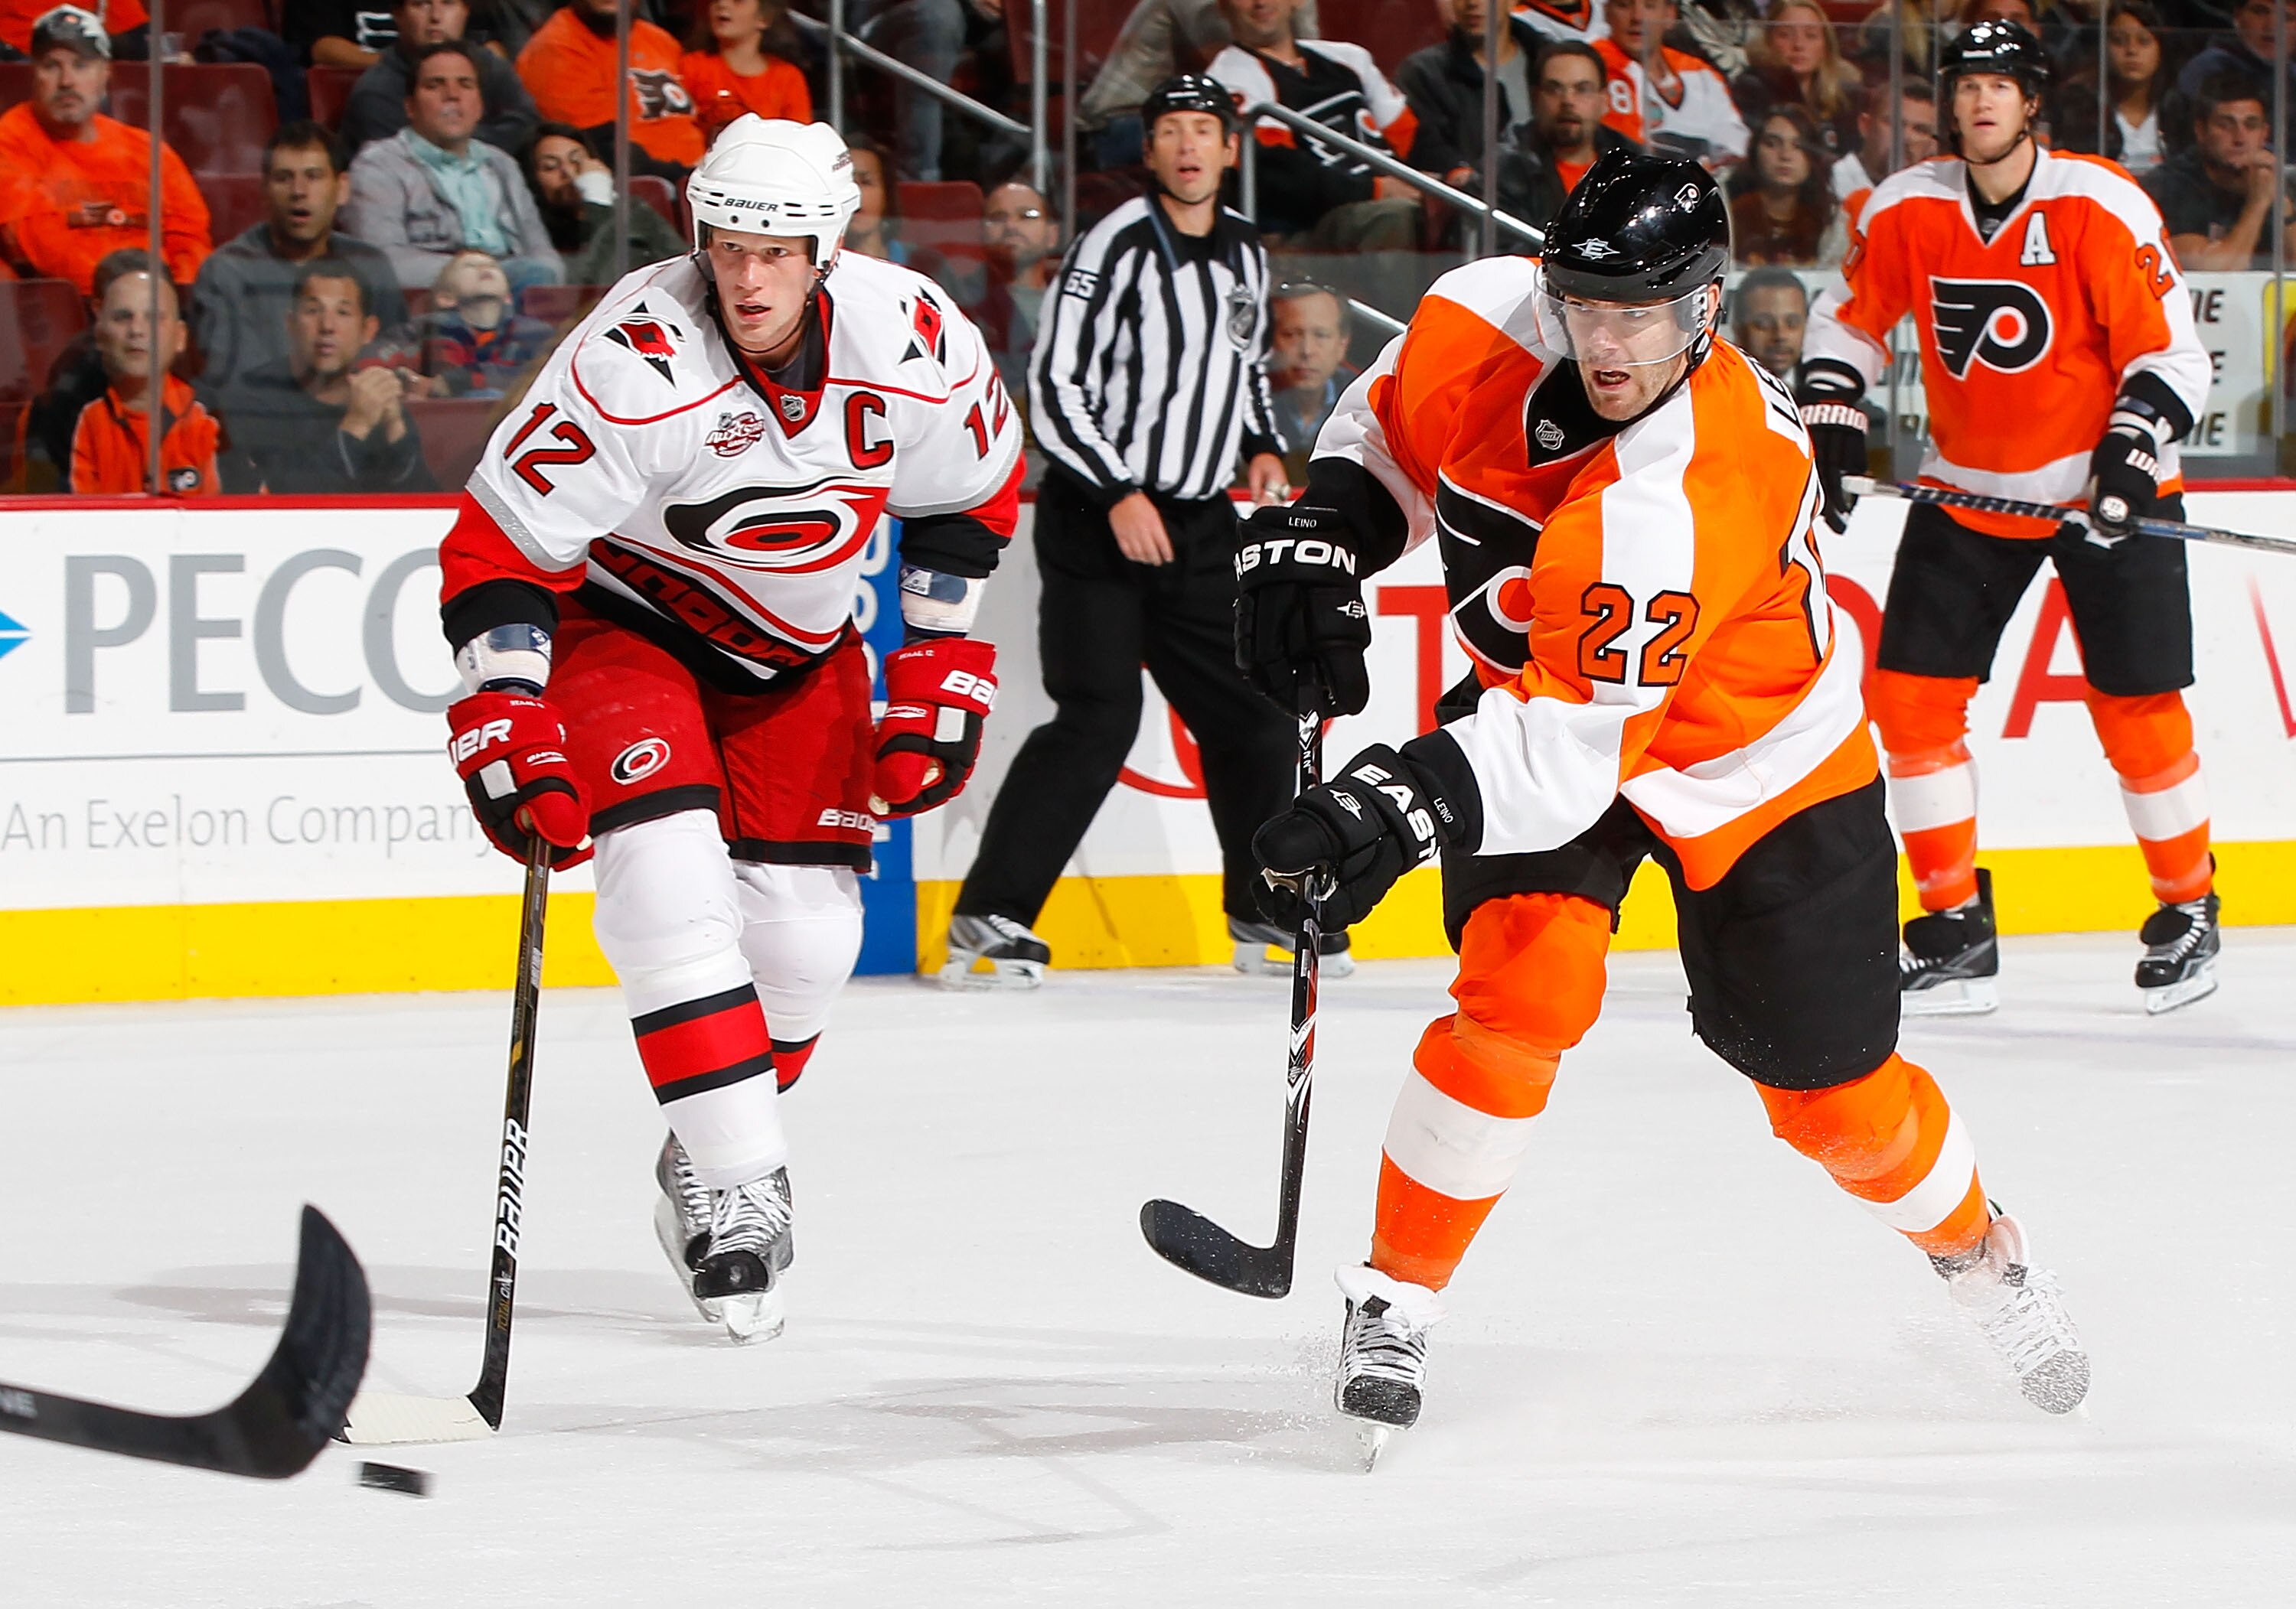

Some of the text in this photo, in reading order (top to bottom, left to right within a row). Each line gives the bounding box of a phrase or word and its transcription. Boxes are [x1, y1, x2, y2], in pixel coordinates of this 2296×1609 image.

[2020, 210, 2056, 266] A
[2135, 226, 2183, 300] 2
[844, 390, 894, 470] C
[964, 366, 1009, 461] 12
[504, 402, 596, 497] 12
[1288, 516, 1317, 528] LEINO
[1233, 539, 1356, 581] ASTON
[1578, 581, 1700, 687] 22
[3, 802, 67, 850] An
[87, 794, 248, 848] Exelon
[1433, 797, 1454, 823] LEINO
